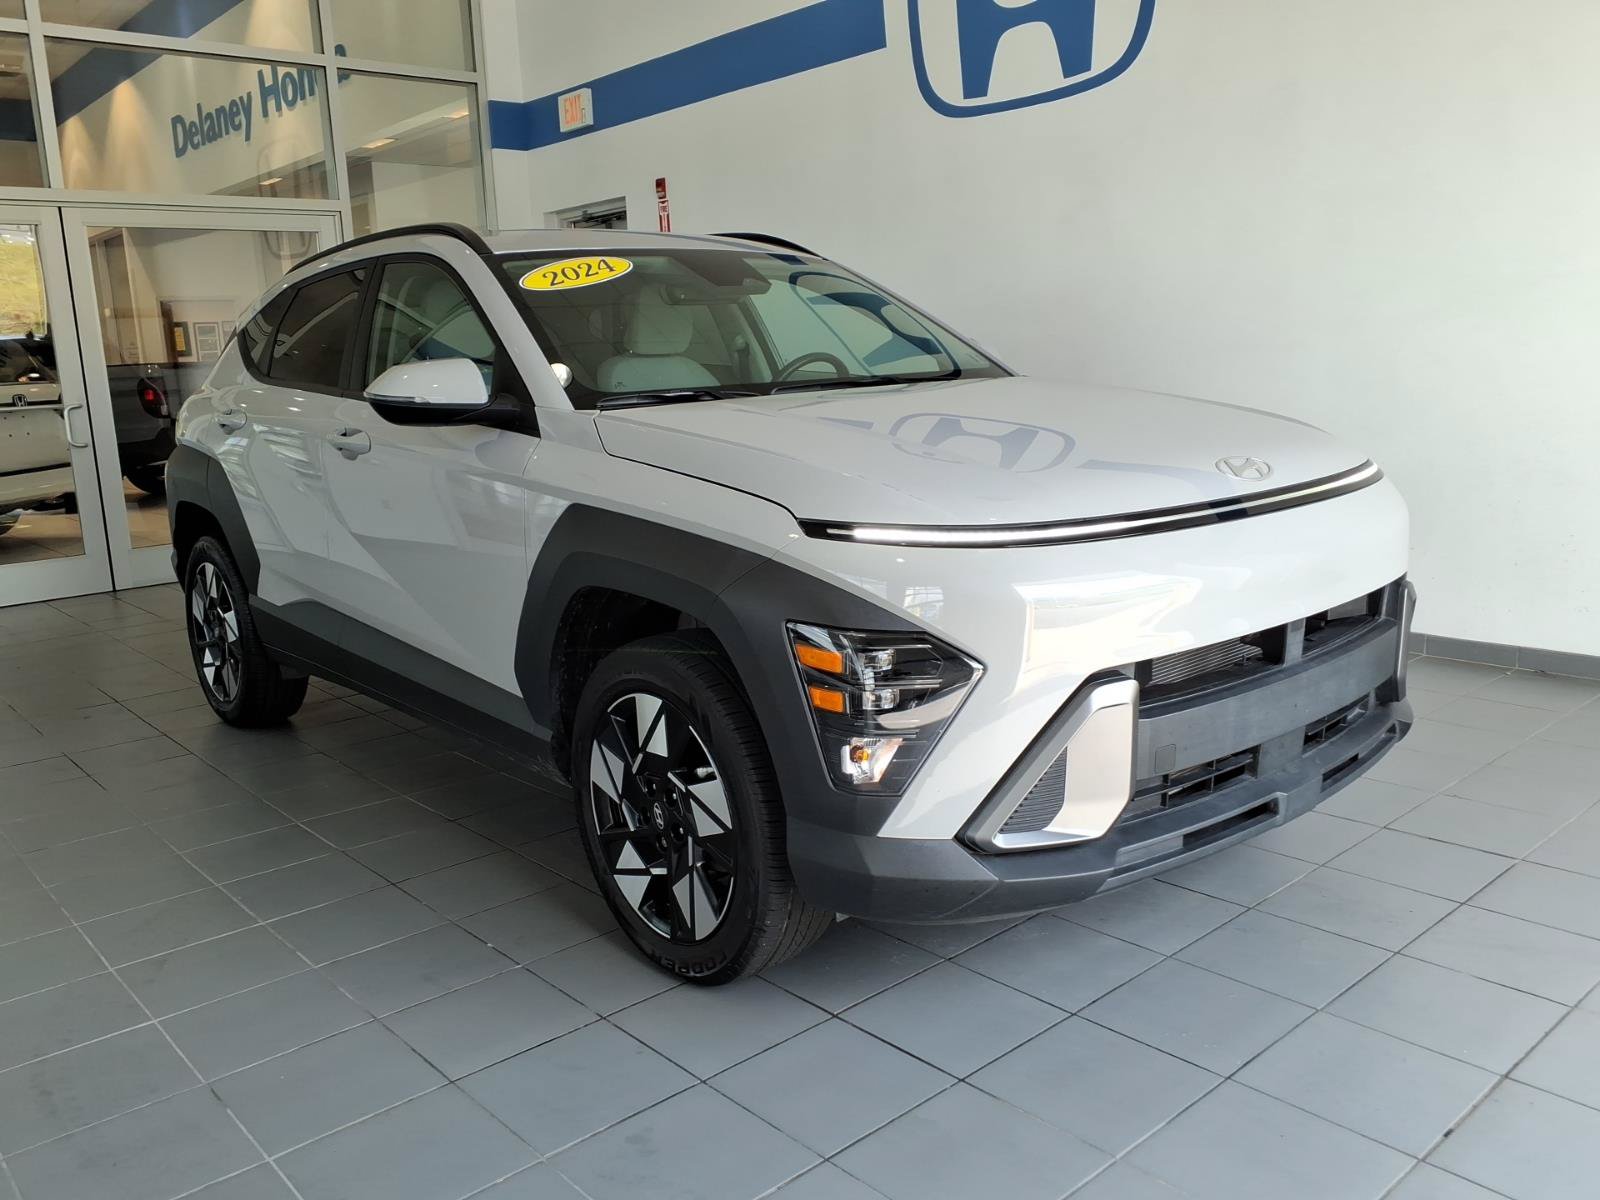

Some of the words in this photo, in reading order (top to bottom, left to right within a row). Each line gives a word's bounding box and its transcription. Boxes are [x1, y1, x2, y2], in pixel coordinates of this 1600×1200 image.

[171, 91, 252, 158] Delaney
[257, 44, 351, 118] Hona
[563, 94, 582, 126] EXIT
[542, 259, 616, 286] 2024
